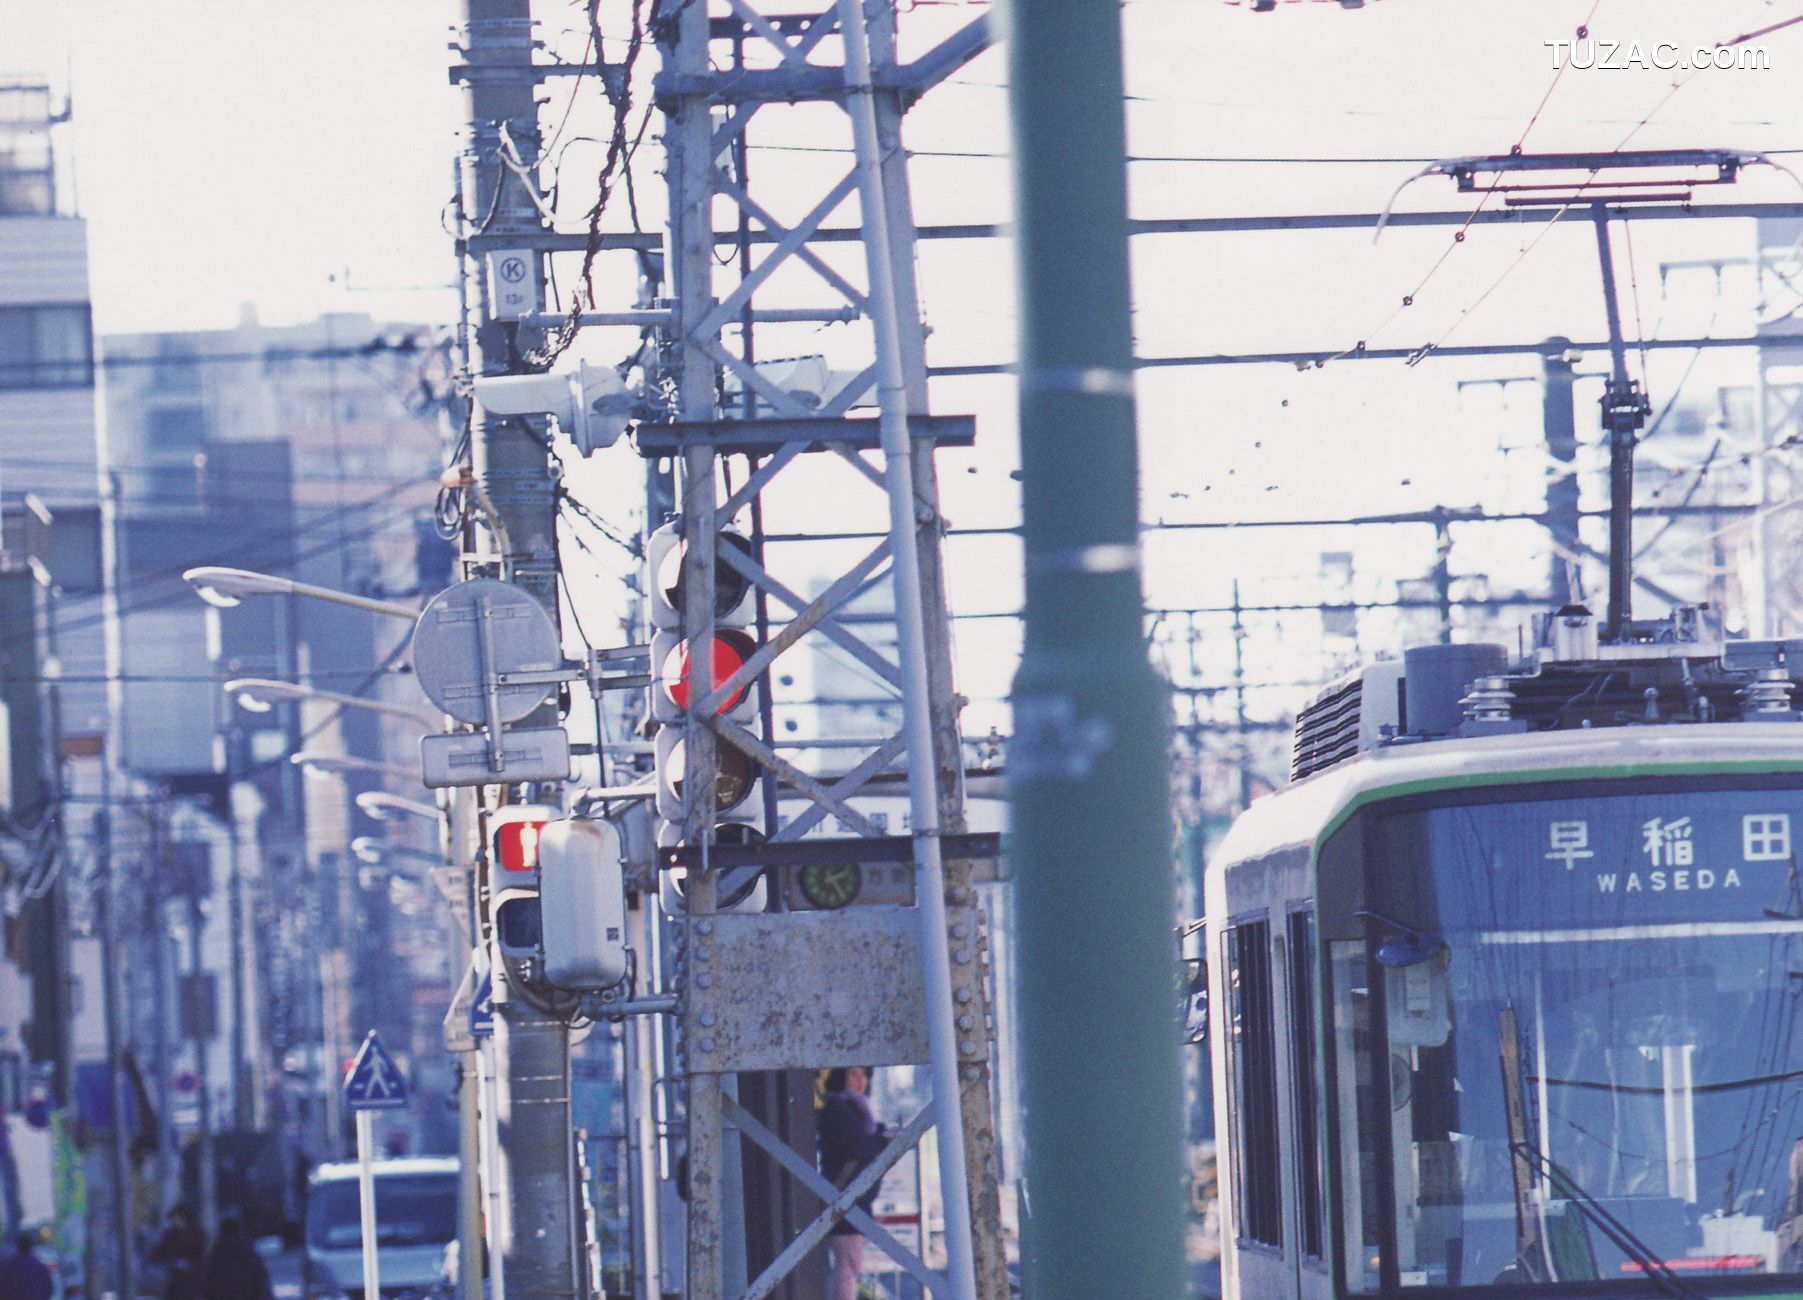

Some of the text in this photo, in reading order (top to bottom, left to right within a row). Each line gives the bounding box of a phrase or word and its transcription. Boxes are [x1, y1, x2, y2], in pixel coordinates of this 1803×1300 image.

[1544, 813, 1792, 871] 早稲田
[1597, 868, 1742, 893] WASEDA
